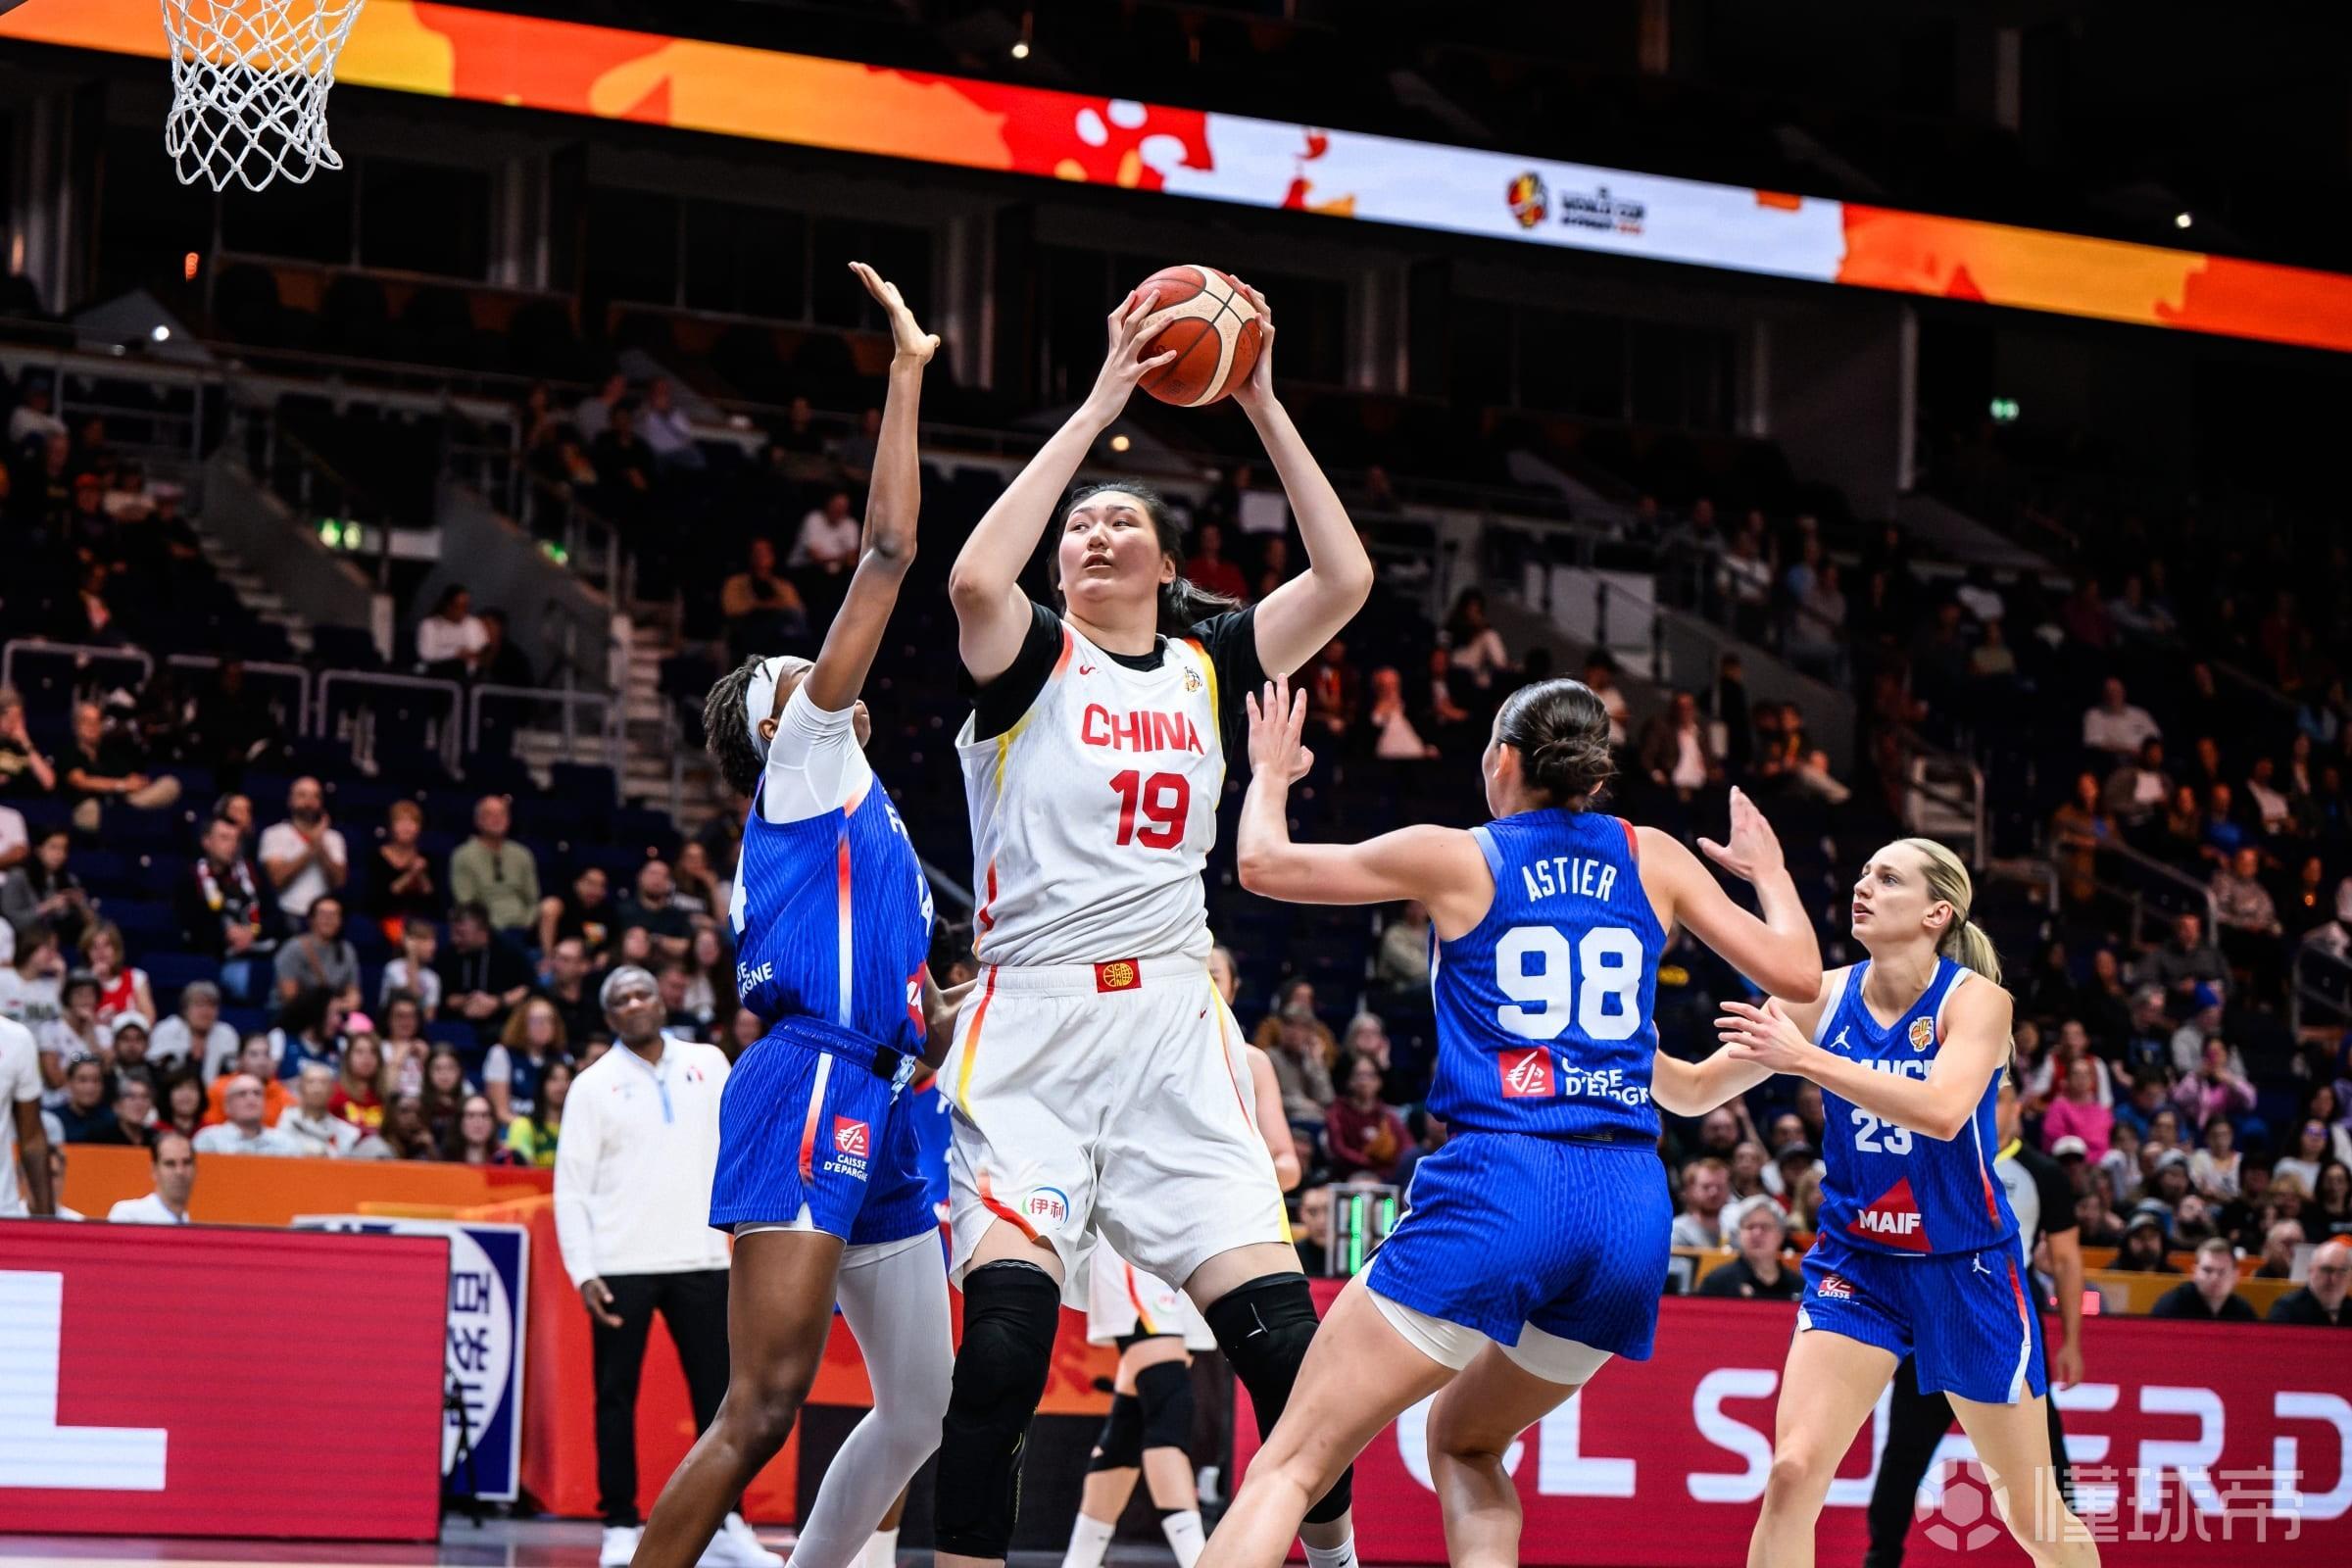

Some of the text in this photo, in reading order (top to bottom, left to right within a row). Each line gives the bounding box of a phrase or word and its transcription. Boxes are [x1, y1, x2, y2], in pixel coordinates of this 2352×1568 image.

[1081, 703, 1204, 756] CHINA
[1109, 769, 1191, 850] 19
[1522, 857, 1617, 903] ASTIER
[1495, 925, 1643, 1041] 98
[1851, 1108, 1912, 1155] 23
[837, 1154, 867, 1170] CAISSE
[1030, 1198, 1065, 1221] 伊利
[1858, 1209, 1921, 1234] MAIF
[1818, 1290, 1850, 1299] CAISSE
